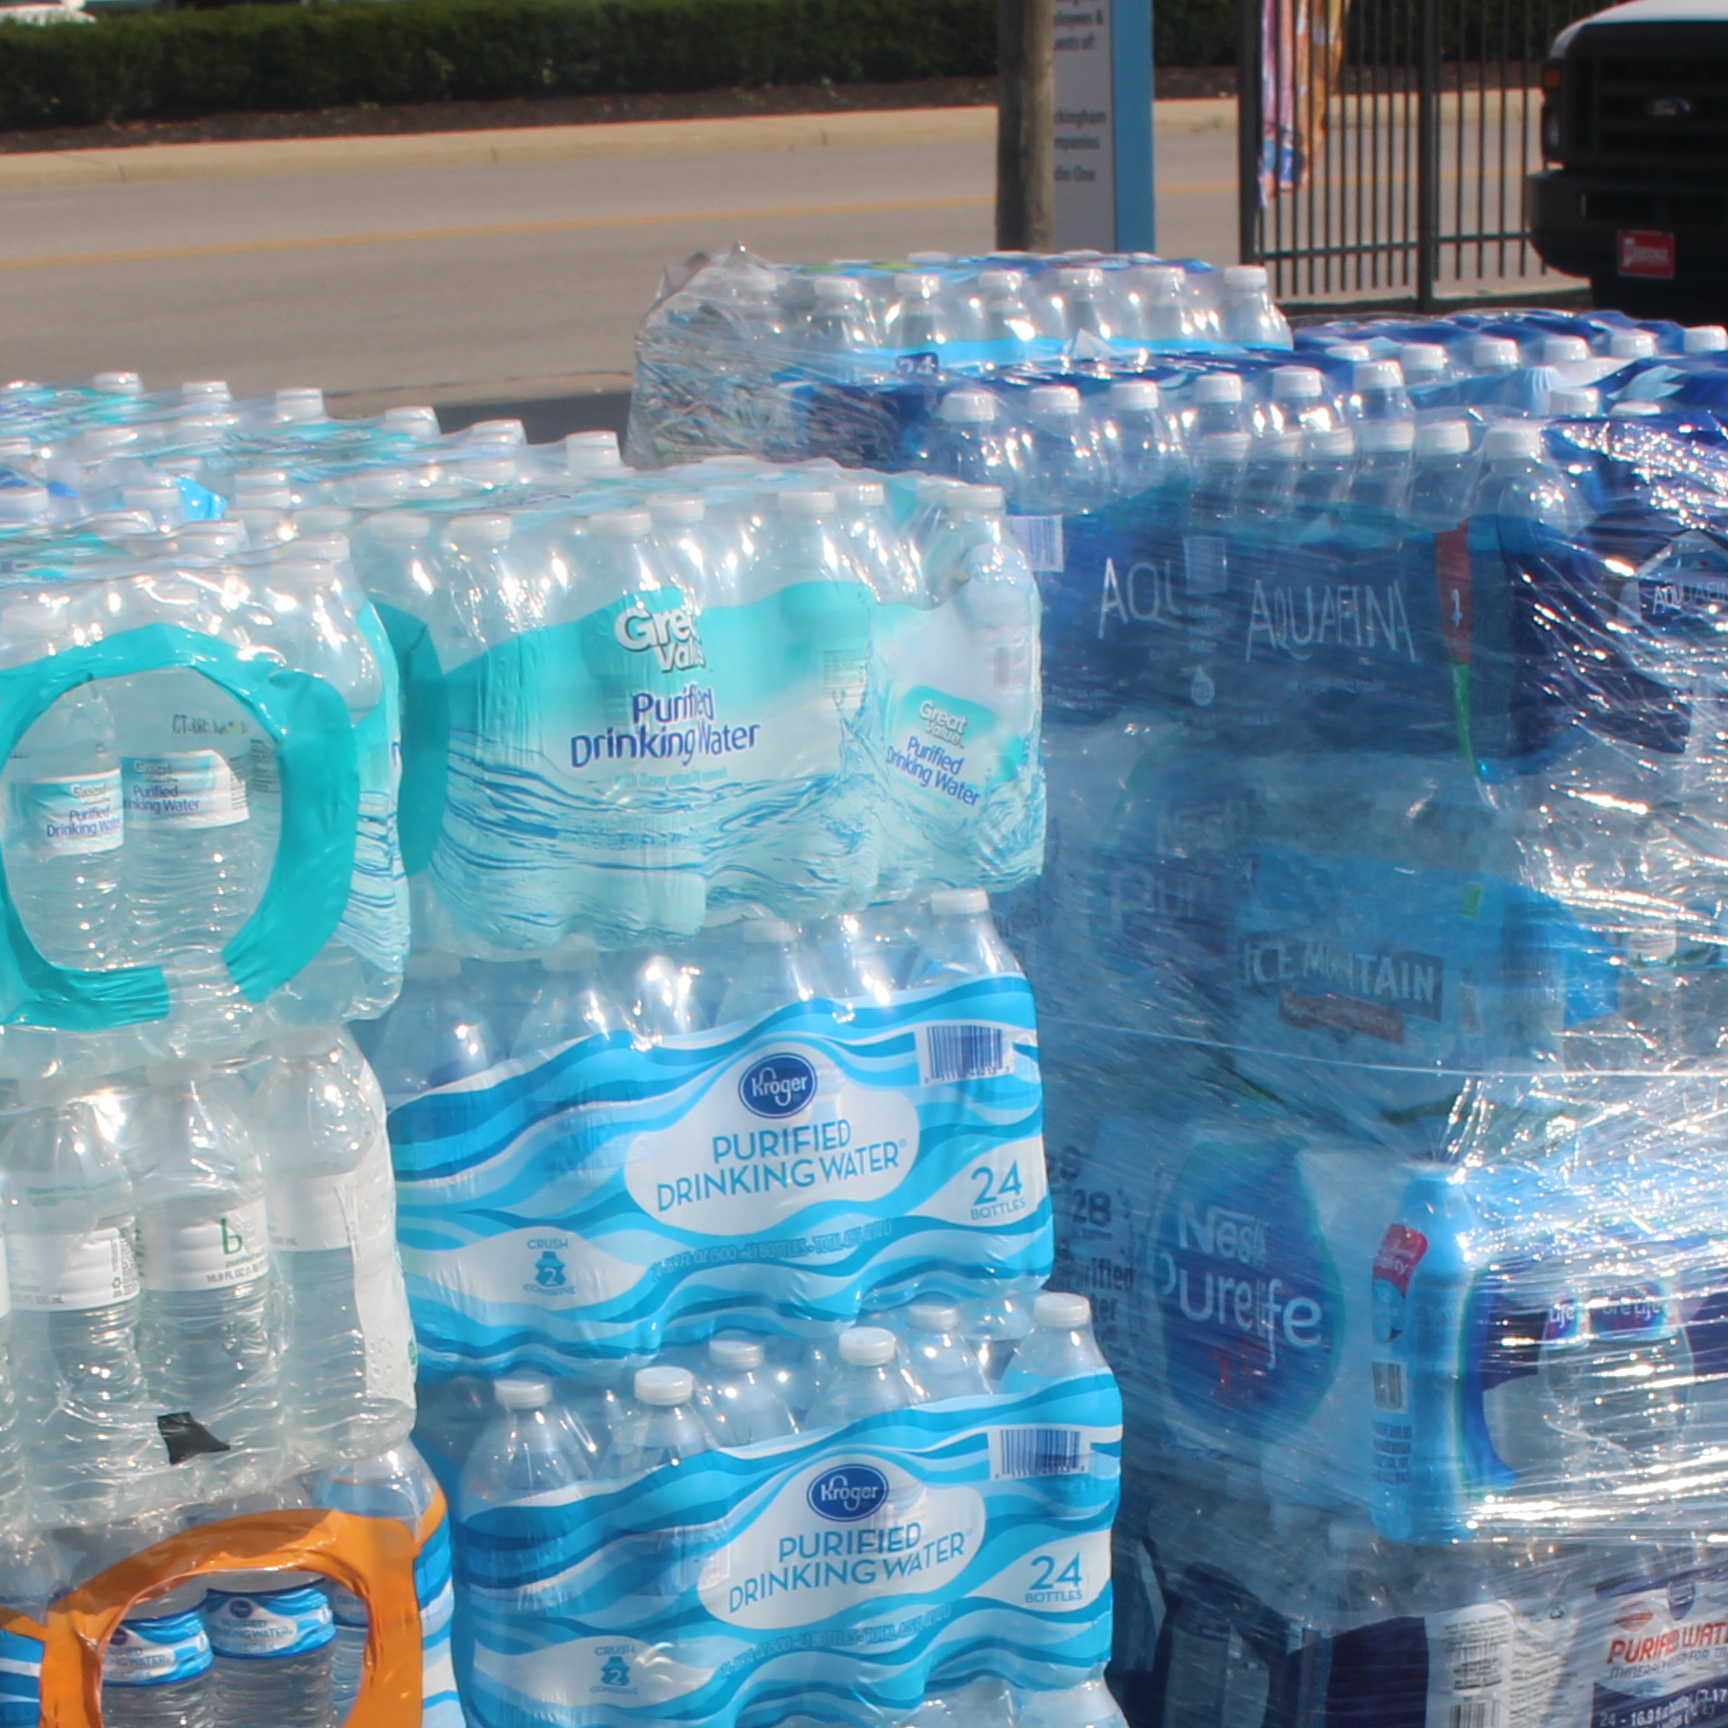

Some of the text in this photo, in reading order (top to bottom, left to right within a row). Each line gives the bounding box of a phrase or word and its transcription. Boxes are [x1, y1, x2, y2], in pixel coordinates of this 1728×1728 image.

[1245, 579, 1418, 663] AQUAFINA
[916, 698, 971, 732] Great
[905, 736, 964, 777] Purified
[933, 766, 981, 807] Water
[122, 795, 202, 815] rinking Water
[750, 1072, 810, 1107] Kroger
[712, 1119, 853, 1164] PURIFIED
[656, 1140, 901, 1212] DRINKING WATER
[970, 1159, 1024, 1203] 24
[970, 1198, 1027, 1220] BOTTLES
[526, 1238, 569, 1251] CRUSH
[543, 1268, 559, 1287] 2
[818, 1480, 881, 1514] Kroger
[778, 1521, 923, 1563] PURIFIED
[728, 1531, 967, 1616] DRINKING WATER
[1029, 1551, 1084, 1592] 24
[1024, 1589, 1085, 1605] BOTTLES
[593, 1645, 636, 1658] CRUSH
[608, 1667, 623, 1685] 2
